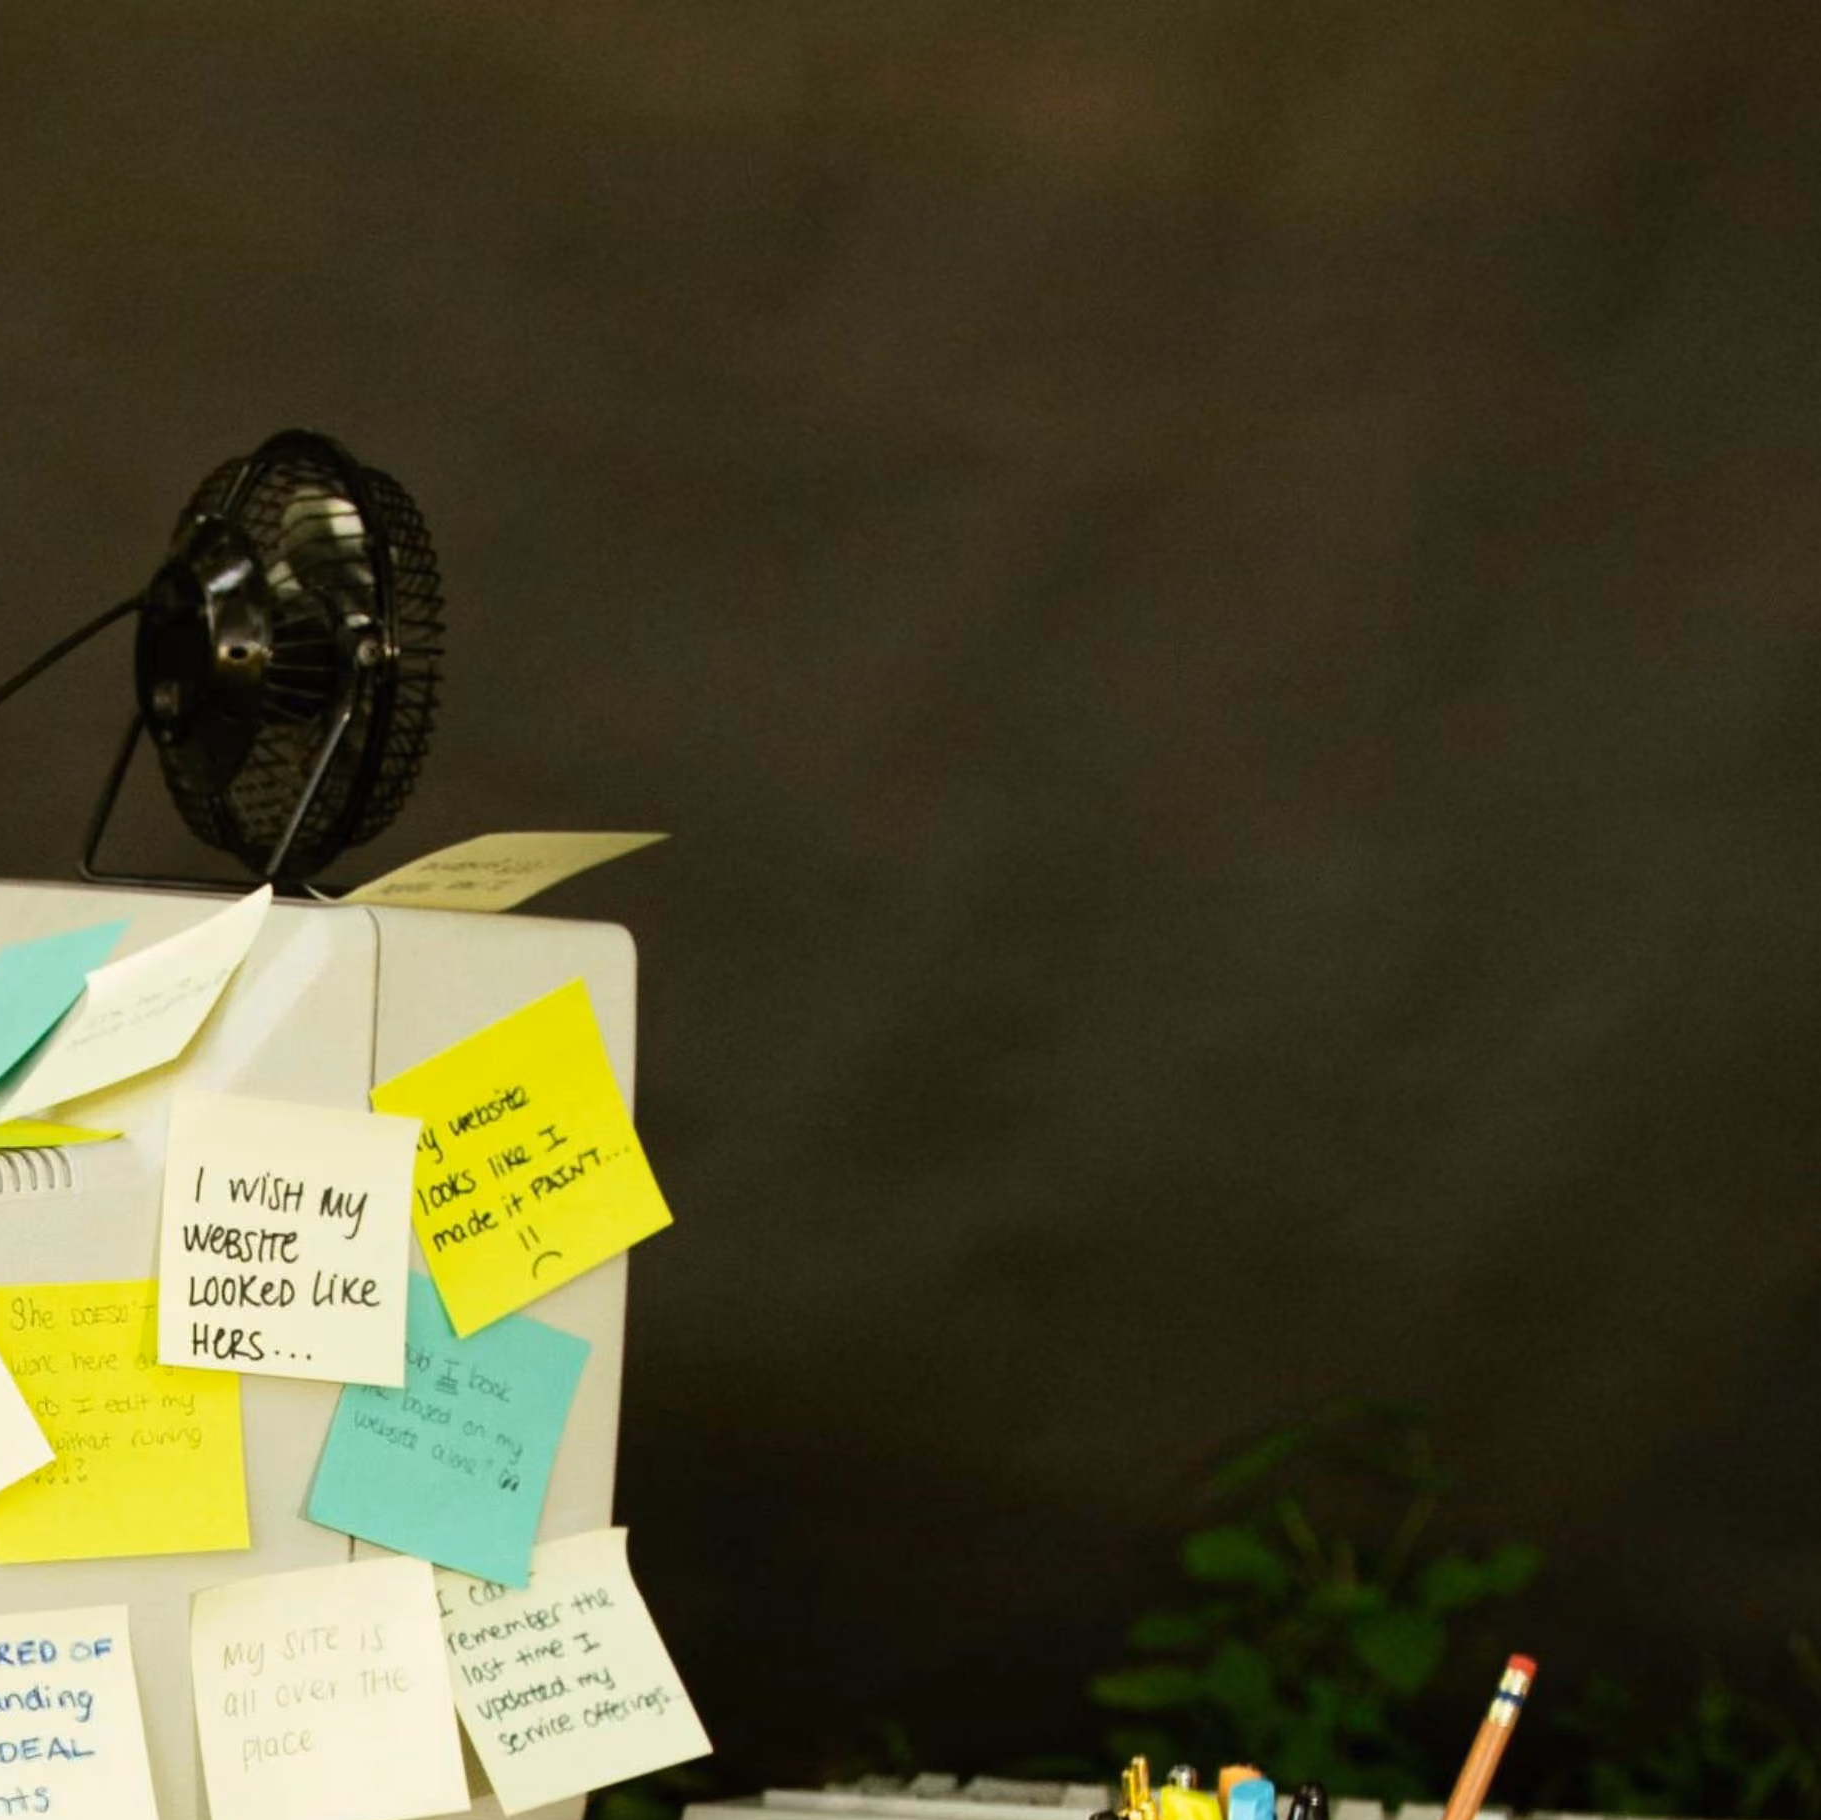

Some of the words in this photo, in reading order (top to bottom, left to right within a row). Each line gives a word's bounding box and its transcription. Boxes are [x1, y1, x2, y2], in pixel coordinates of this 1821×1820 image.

[417, 1129, 443, 1164] y
[449, 1086, 529, 1136] website
[195, 1166, 204, 1202] I
[417, 1169, 476, 1216] looks
[487, 1146, 531, 1178] like
[538, 1125, 567, 1151] I
[433, 1210, 498, 1252] made
[501, 1193, 522, 1217] it
[10, 1297, 54, 1331] She
[72, 1352, 120, 1372] here
[439, 1359, 460, 1384] I
[71, 1398, 94, 1414] I
[105, 1394, 151, 1413] edit
[162, 1393, 196, 1416] my
[131, 1426, 203, 1450] ruining
[463, 1420, 485, 1437] on
[495, 1433, 524, 1466] my
[447, 1602, 565, 1655] remember
[571, 1587, 614, 1616] the
[70, 1637, 113, 1662] OF
[461, 1659, 505, 1686] last
[515, 1639, 565, 1666] time
[573, 1632, 601, 1654] I
[224, 1688, 256, 1717] all
[275, 1679, 339, 1708] over
[477, 1675, 570, 1722] updated
[577, 1667, 616, 1691] my
[499, 1713, 575, 1756] service
